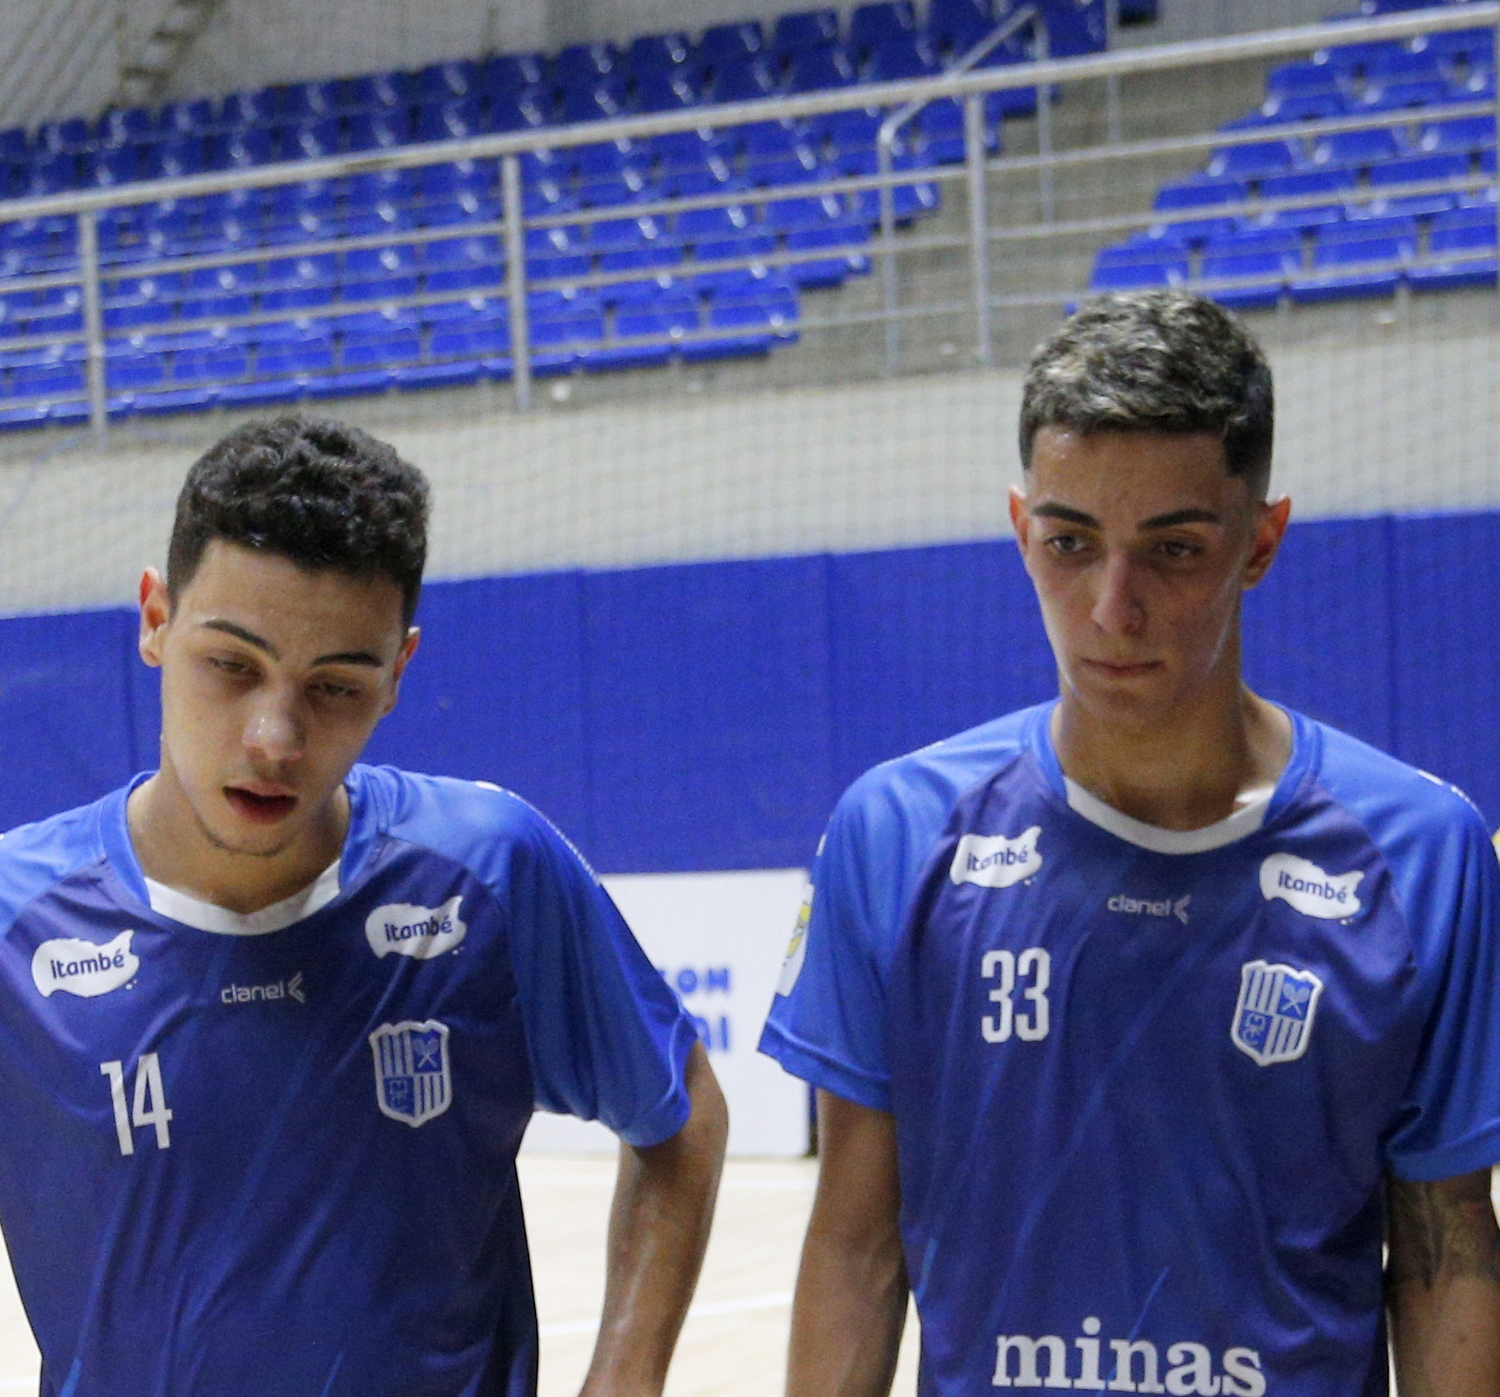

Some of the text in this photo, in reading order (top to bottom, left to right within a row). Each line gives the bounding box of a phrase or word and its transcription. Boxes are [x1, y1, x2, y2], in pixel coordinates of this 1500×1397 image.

[50, 949, 125, 979] itambé
[981, 947, 1051, 1043] 33
[100, 1053, 173, 1156] 14
